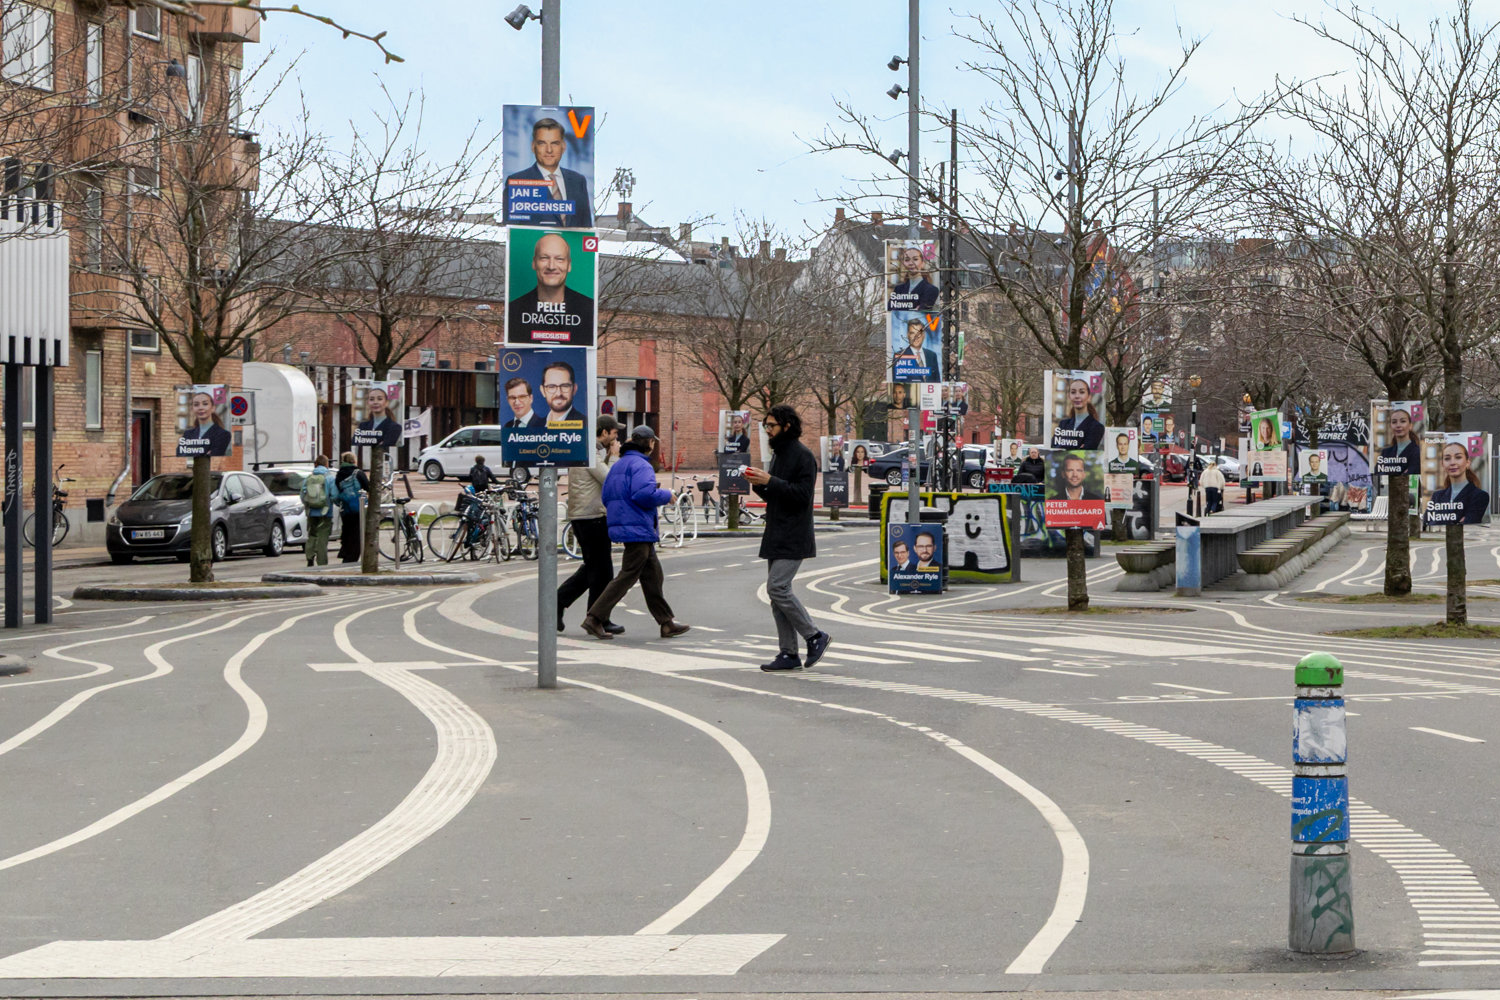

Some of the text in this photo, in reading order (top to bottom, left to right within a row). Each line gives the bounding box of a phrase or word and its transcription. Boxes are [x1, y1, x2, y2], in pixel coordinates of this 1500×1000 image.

[568, 109, 592, 139] V
[510, 188, 542, 199] JAN E.
[510, 202, 573, 213] JØRGENSEN
[890, 292, 919, 300] Samira
[537, 301, 566, 313] PELLE
[890, 301, 914, 309] Nawa
[521, 312, 581, 326] DRAGSTED
[927, 384, 934, 393] B
[1090, 375, 1103, 394] B
[1410, 404, 1425, 422] B
[507, 432, 582, 444] Alexander Ryle
[1054, 427, 1084, 438] Samira
[1128, 430, 1136, 441] B
[179, 437, 211, 446] Samira
[1054, 437, 1078, 447] Nawa
[1467, 436, 1484, 457] B
[179, 446, 205, 454] Nawa
[1319, 451, 1326, 460] B
[1377, 455, 1408, 464] Samira
[1377, 464, 1402, 473] Nawa
[1426, 500, 1464, 511] Samira
[1427, 511, 1457, 522] Nawa
[924, 573, 939, 581] Ryle
